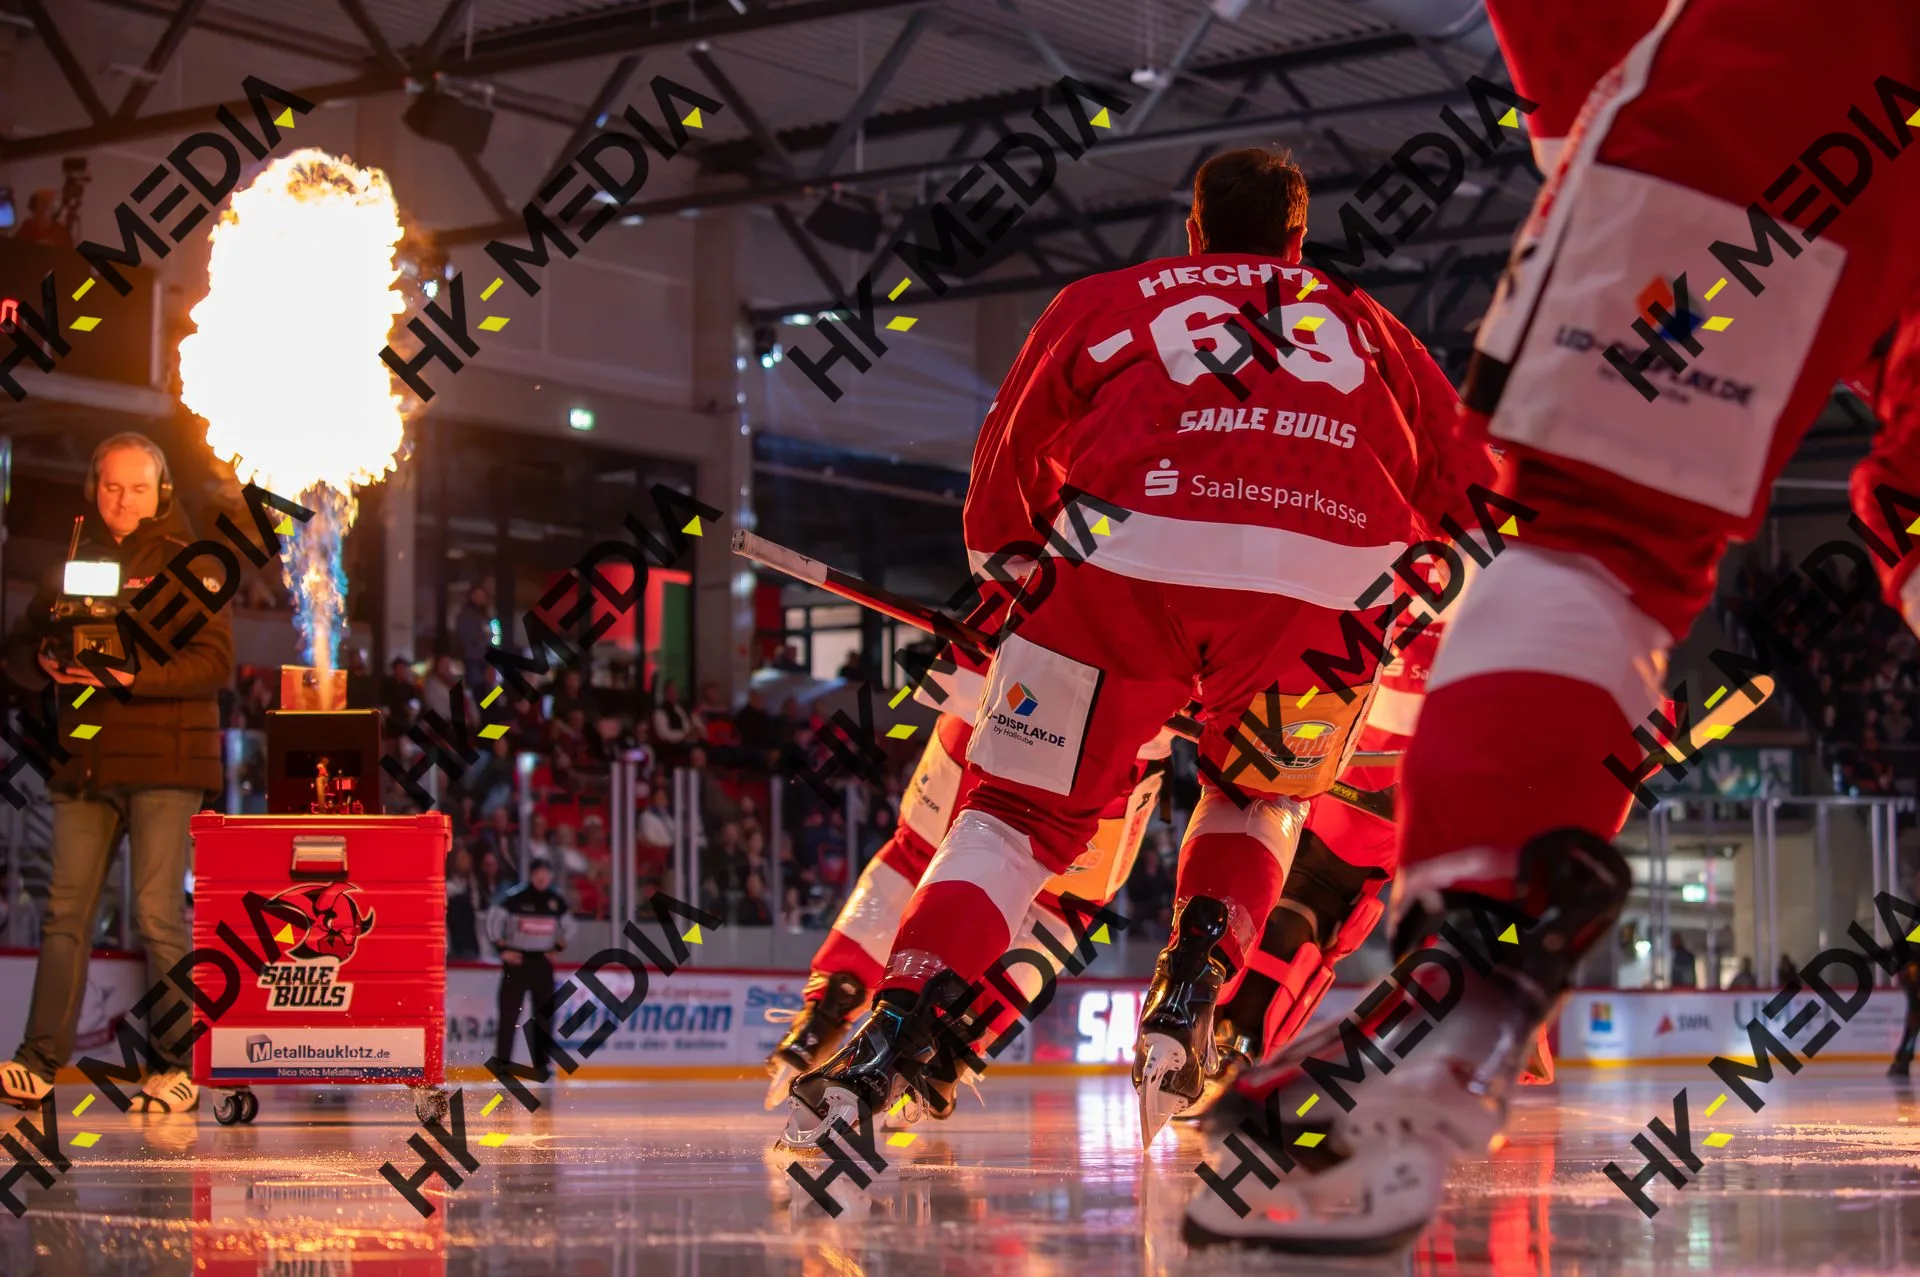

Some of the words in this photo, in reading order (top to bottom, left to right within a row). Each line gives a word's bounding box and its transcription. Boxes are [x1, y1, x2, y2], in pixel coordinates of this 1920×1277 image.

[1149, 295, 1365, 395] 69
[1177, 407, 1270, 434] SAALE
[1273, 410, 1357, 449] BULLS
[1191, 475, 1367, 529] Saalesparkasse
[261, 966, 334, 985] SAALE
[273, 986, 346, 1007] BULLS
[252, 1040, 391, 1063] Metallbauklotz.de
[277, 1068, 297, 1077] Nico
